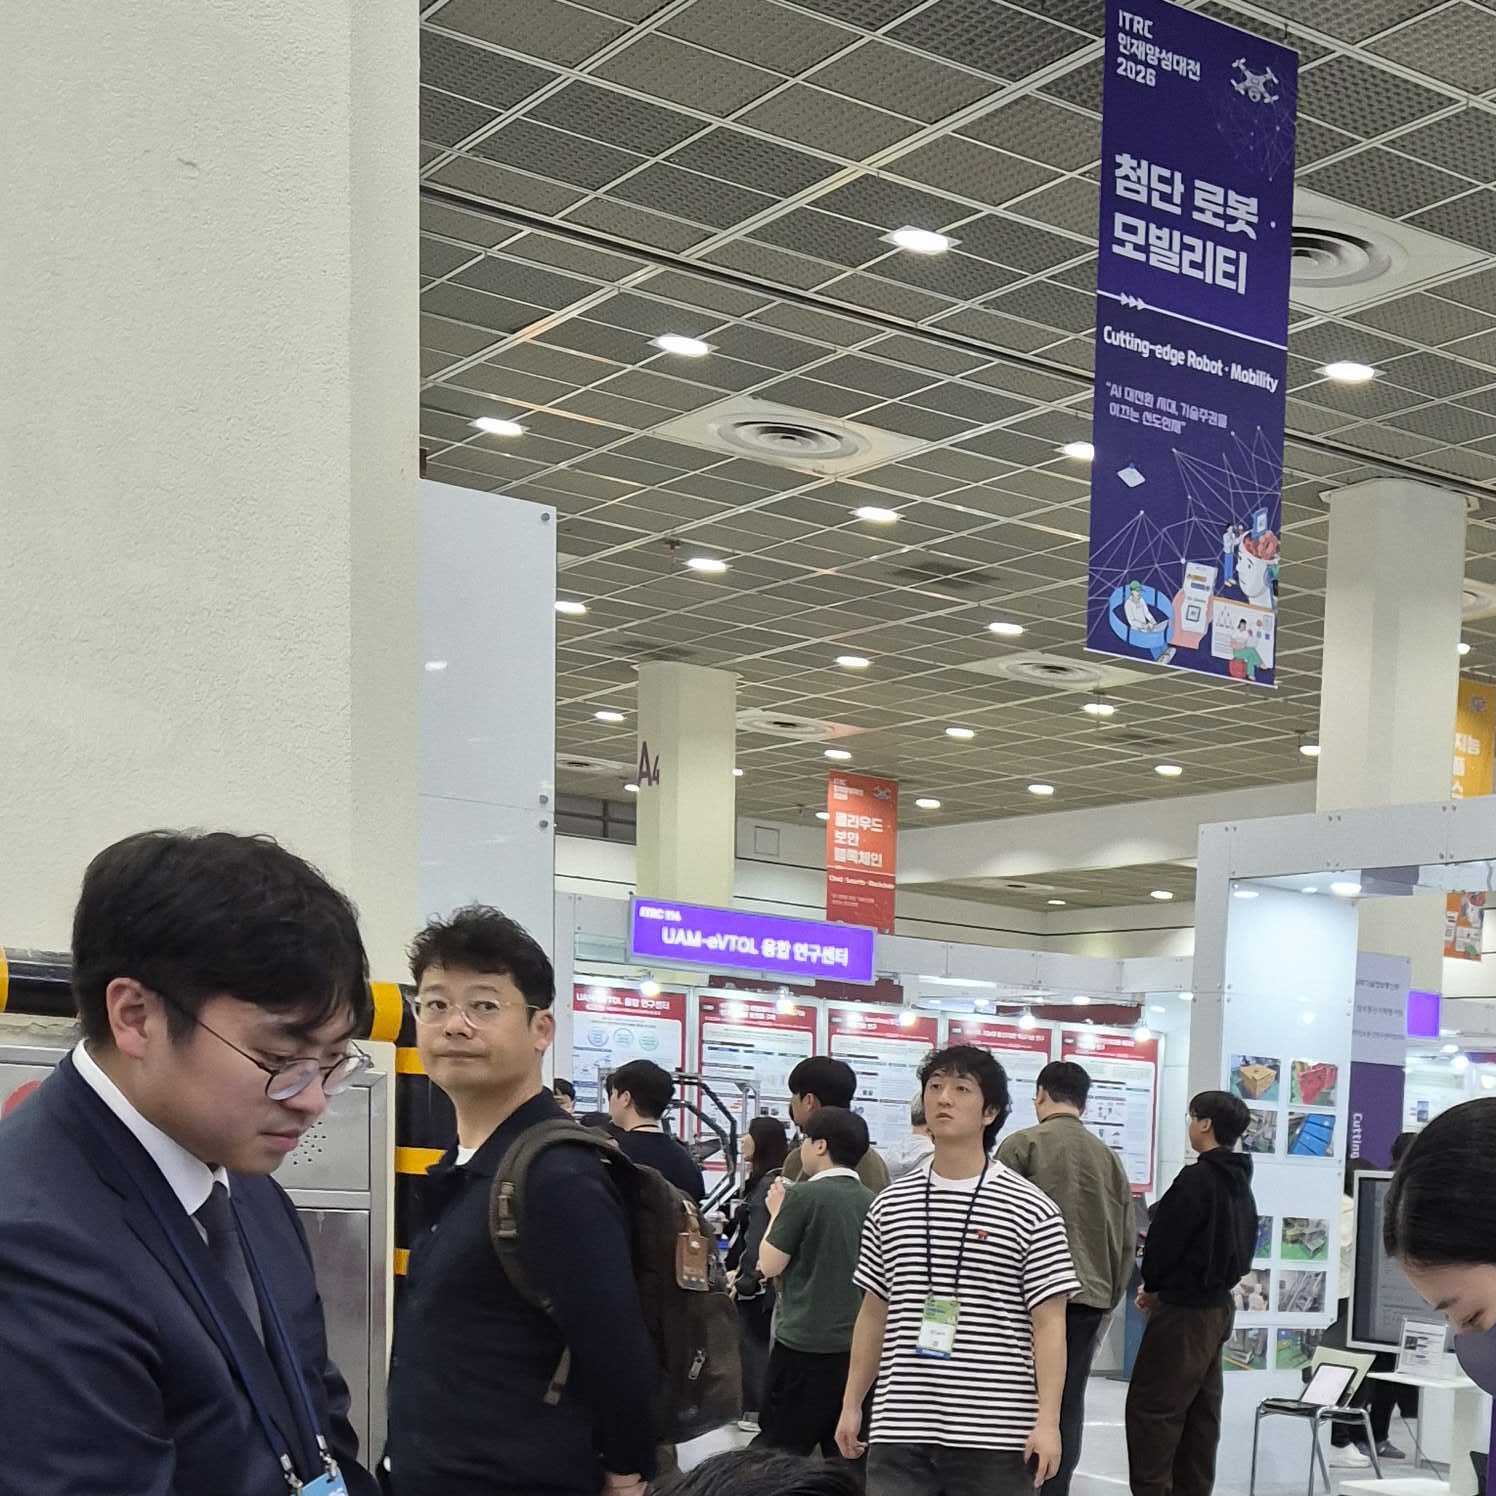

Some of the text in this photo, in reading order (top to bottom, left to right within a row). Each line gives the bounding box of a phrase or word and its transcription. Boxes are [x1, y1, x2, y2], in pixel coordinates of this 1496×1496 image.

[1118, 9, 1153, 38] ITRC
[1116, 57, 1156, 87] 2026
[1117, 35, 1200, 82] 인재양성대전
[1115, 153, 1185, 215] 첨단
[1112, 212, 1248, 295] 모빌리티
[1103, 326, 1279, 393] Cutting-edge Robot Mobility
[638, 741, 660, 786] A4
[661, 927, 849, 968] UAM-eVTOL 융합 연구센터
